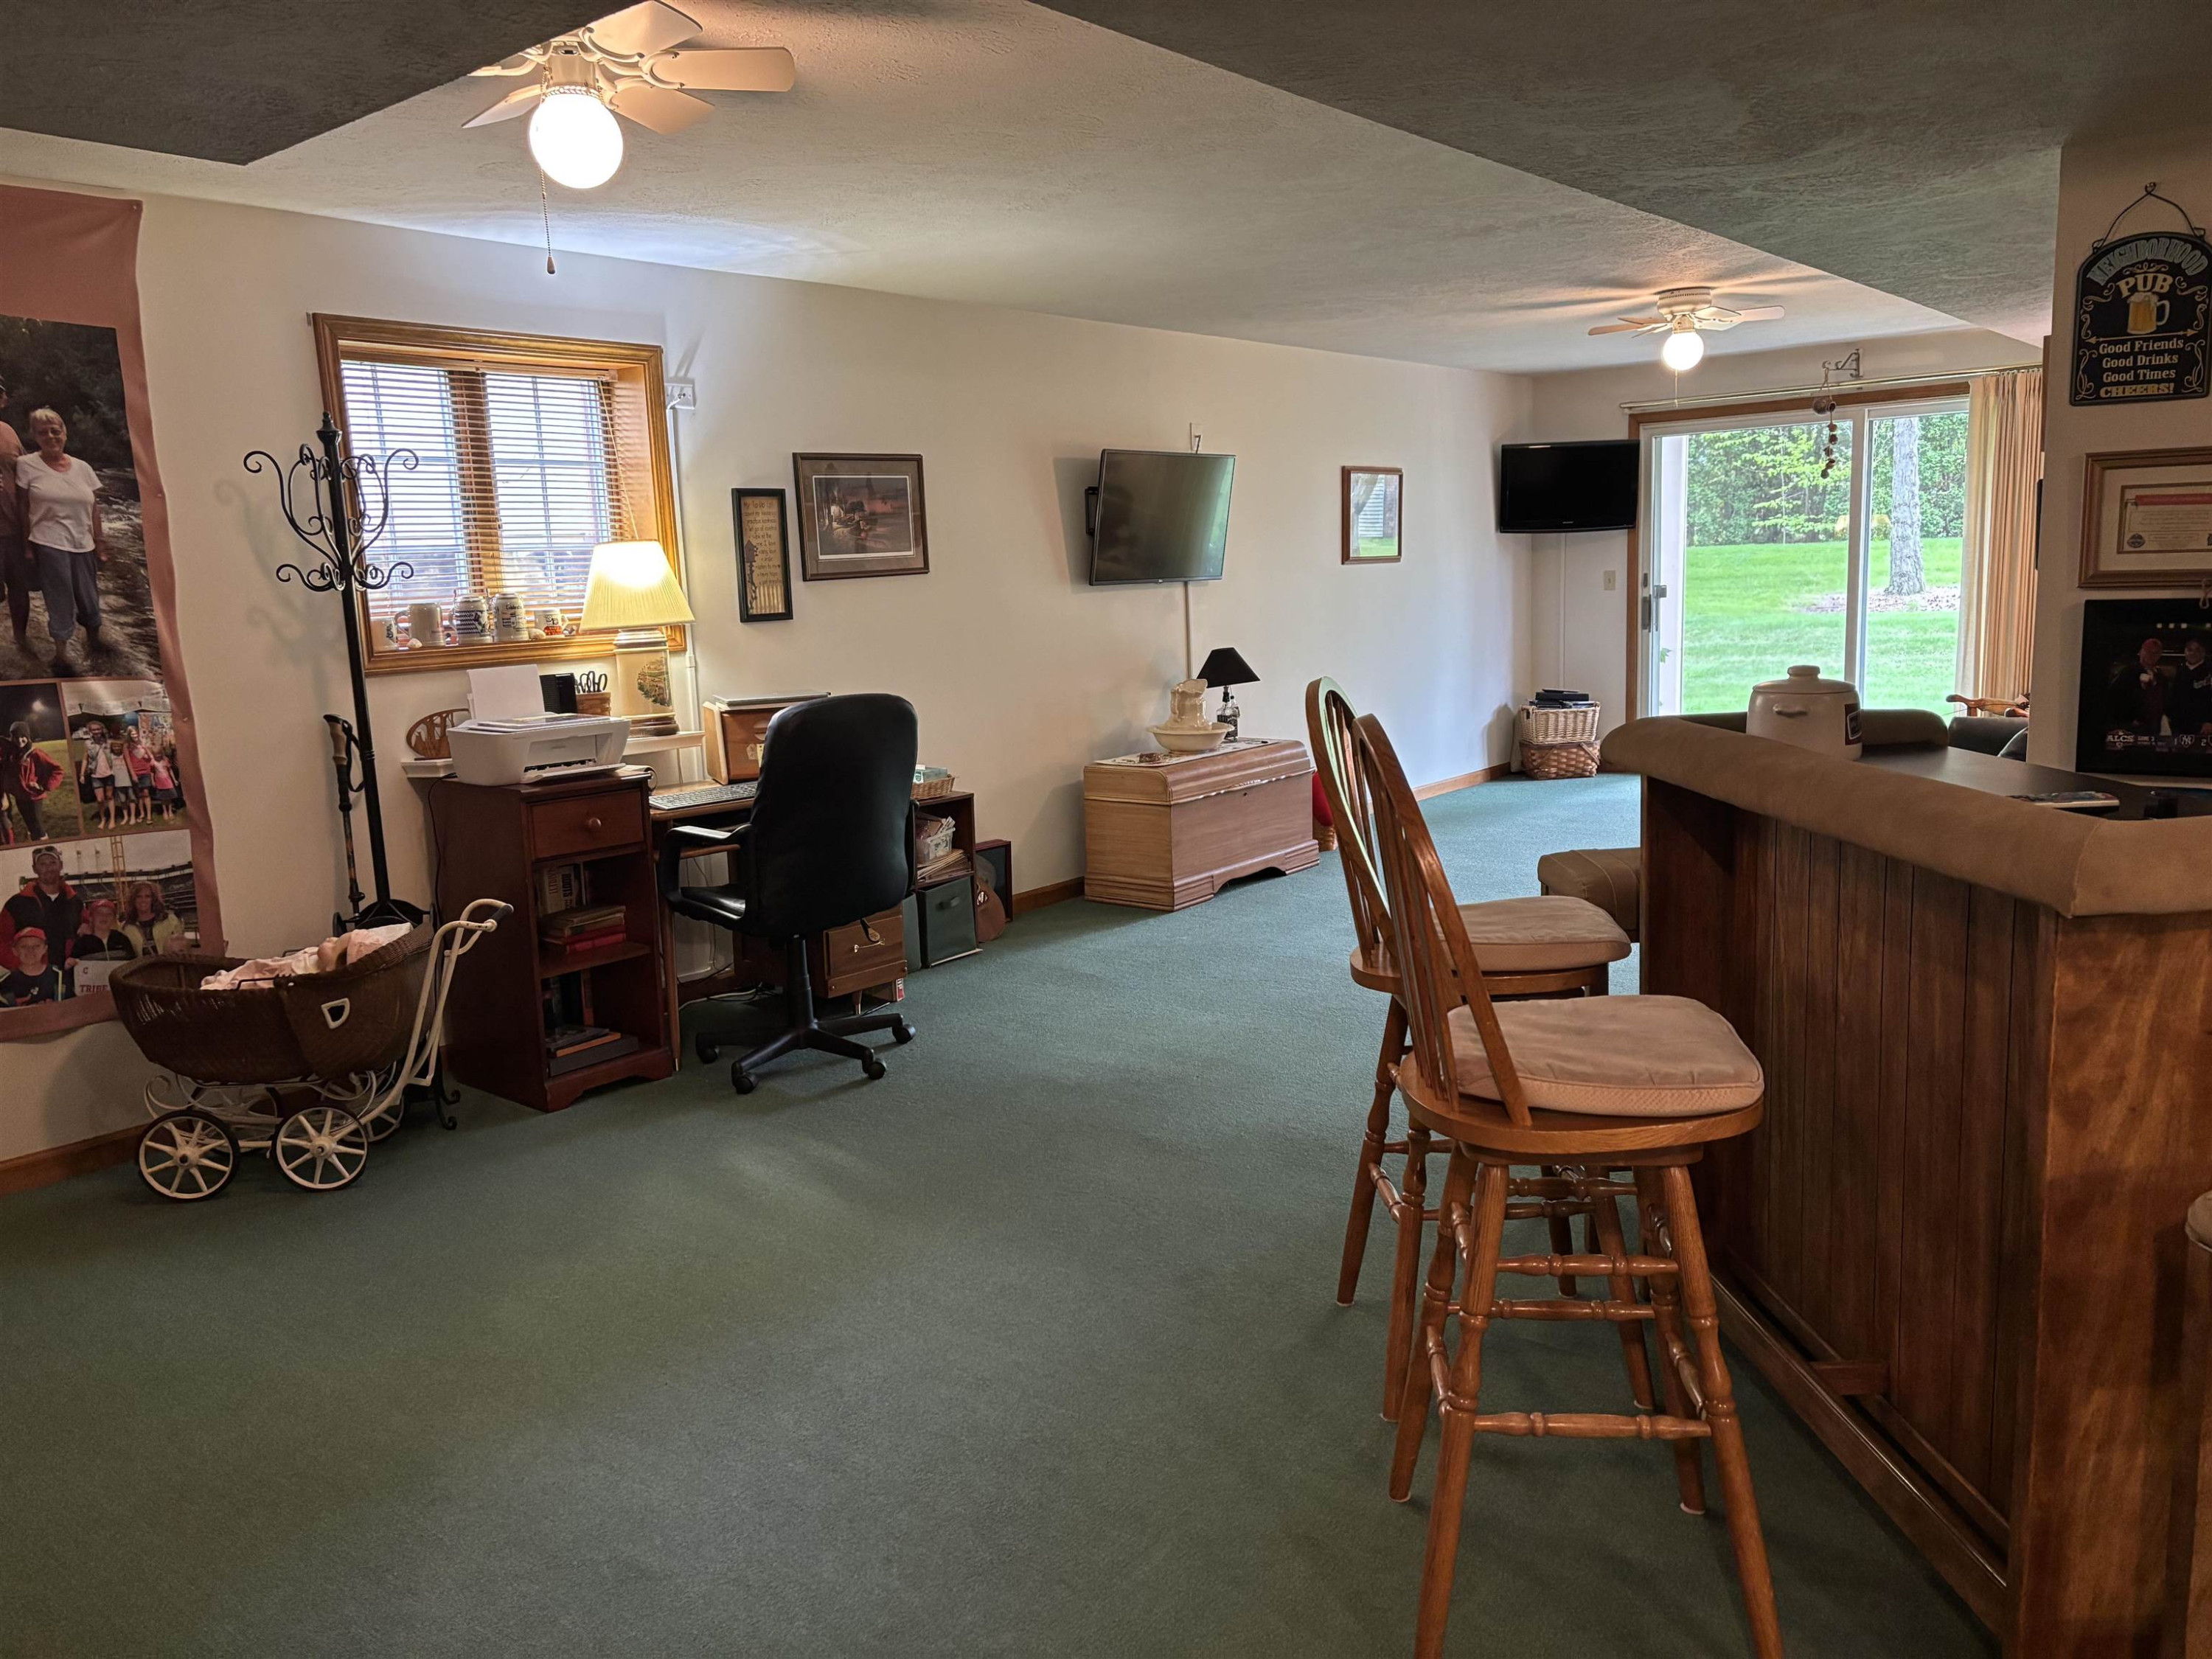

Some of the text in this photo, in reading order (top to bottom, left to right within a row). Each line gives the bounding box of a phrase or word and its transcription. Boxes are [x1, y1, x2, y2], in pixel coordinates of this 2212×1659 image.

[2087, 237, 2208, 286] NEIGHBORHOOD
[2116, 273, 2174, 299] PUB
[2098, 338, 2184, 354] Good Friends
[2102, 353, 2179, 368] Good Drinks
[2103, 369, 2176, 383] Good Times
[2099, 383, 2174, 398] CHEERS!
